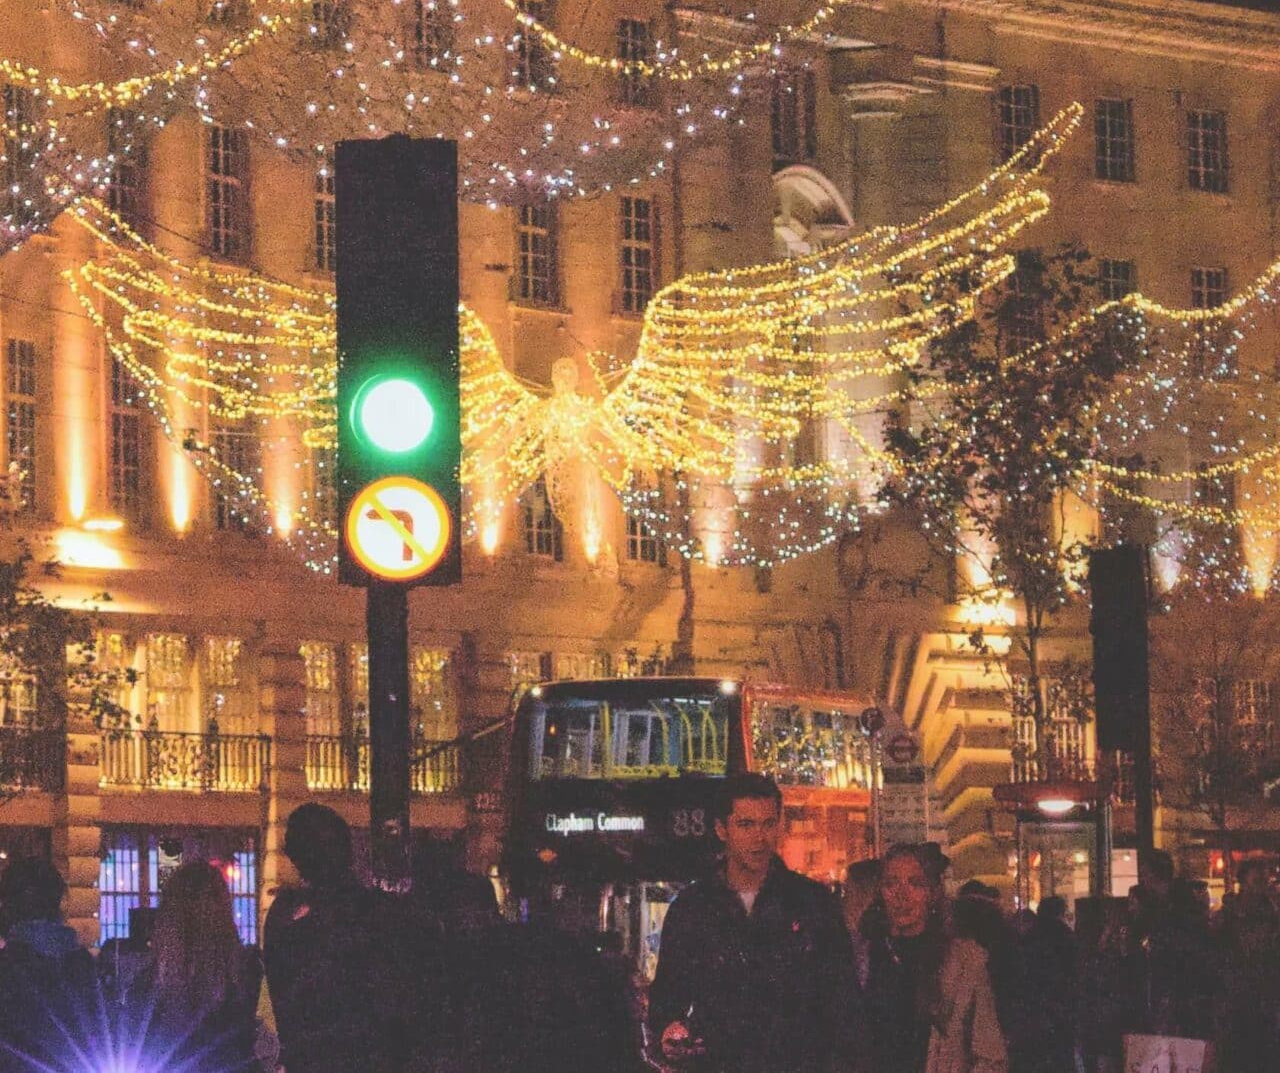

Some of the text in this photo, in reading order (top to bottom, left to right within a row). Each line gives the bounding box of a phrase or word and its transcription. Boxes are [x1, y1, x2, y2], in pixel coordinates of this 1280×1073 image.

[546, 809, 706, 837] Clapham Common 88
